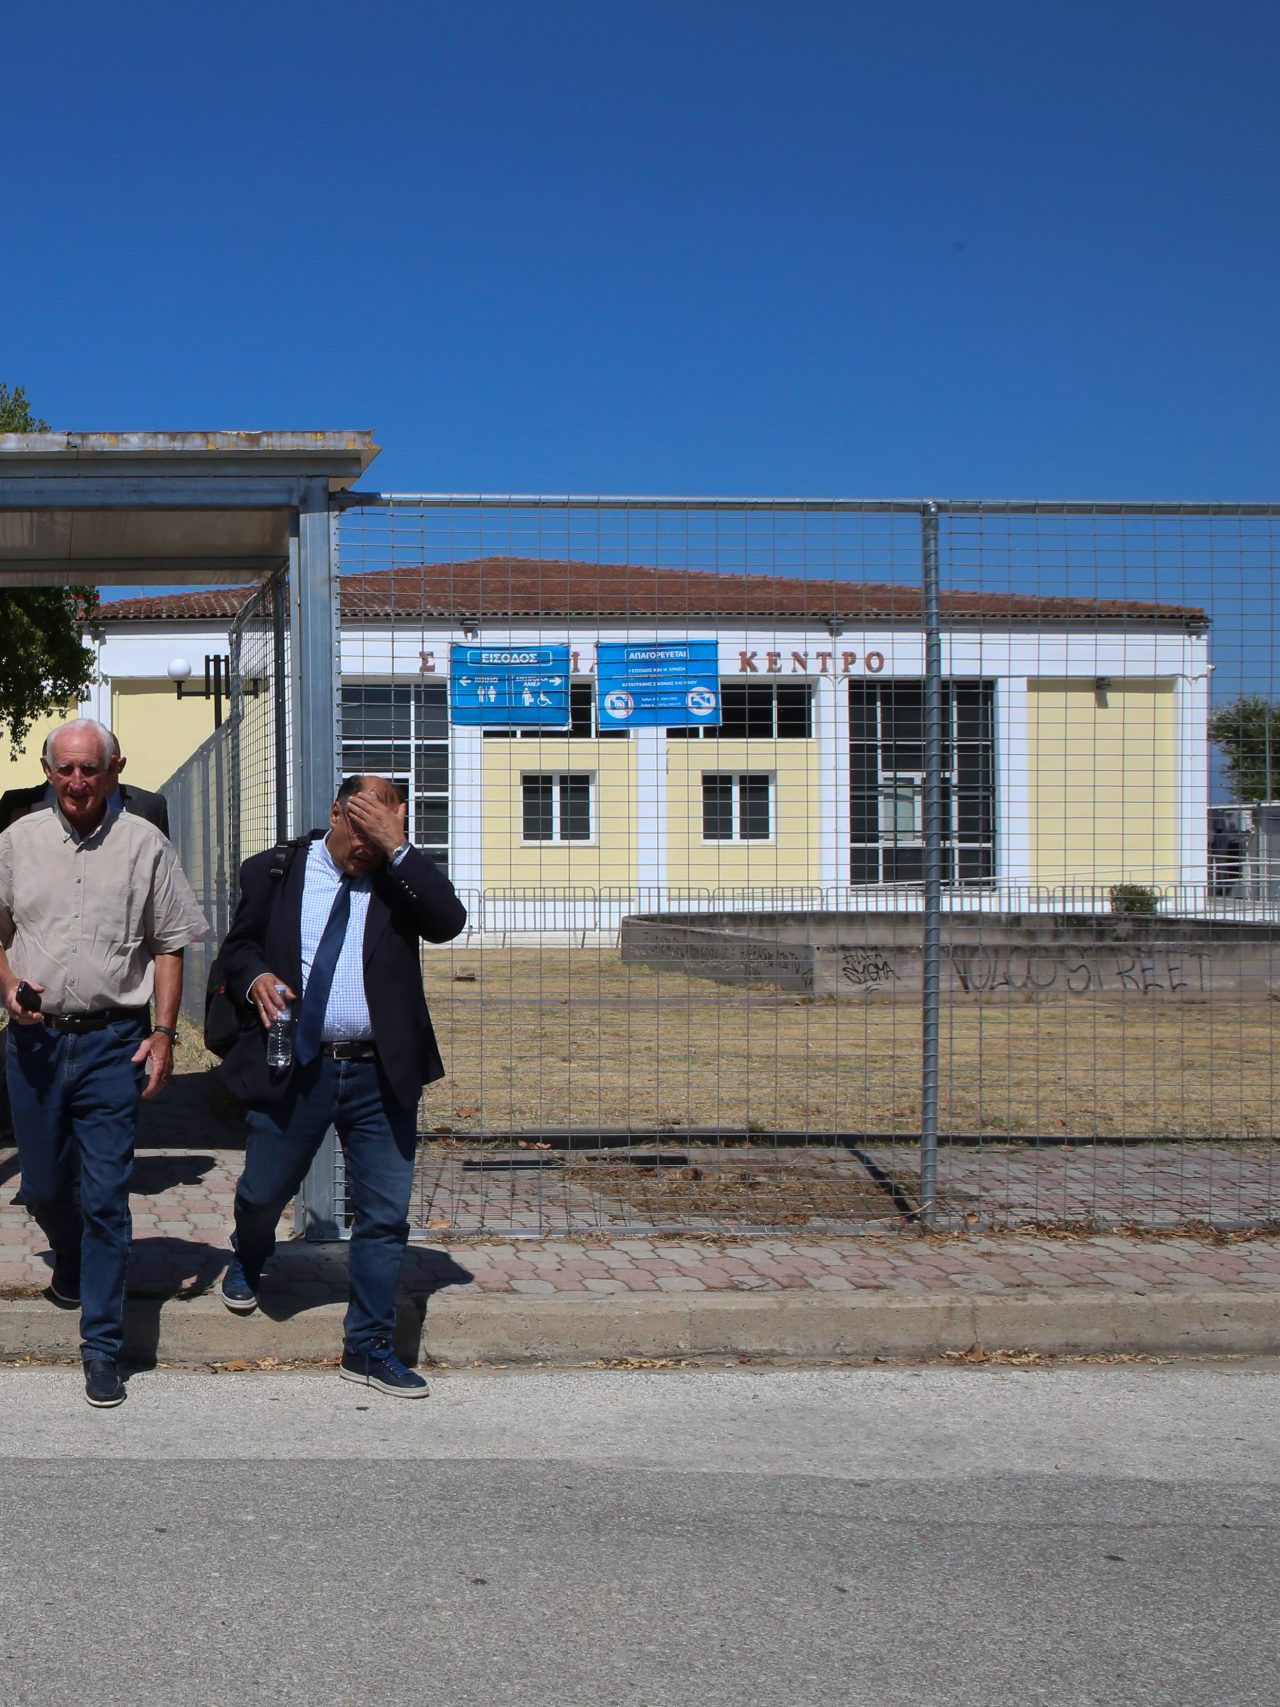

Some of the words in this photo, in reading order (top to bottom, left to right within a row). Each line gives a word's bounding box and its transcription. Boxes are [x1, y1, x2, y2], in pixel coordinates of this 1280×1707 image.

[481, 653, 538, 664] ΕΙΣΟΔΟΣ
[629, 650, 687, 659] ΑΠΑΓΟΡΕΥΕΤΑΙ
[738, 651, 885, 673] ΚΕΝΤΡΟ
